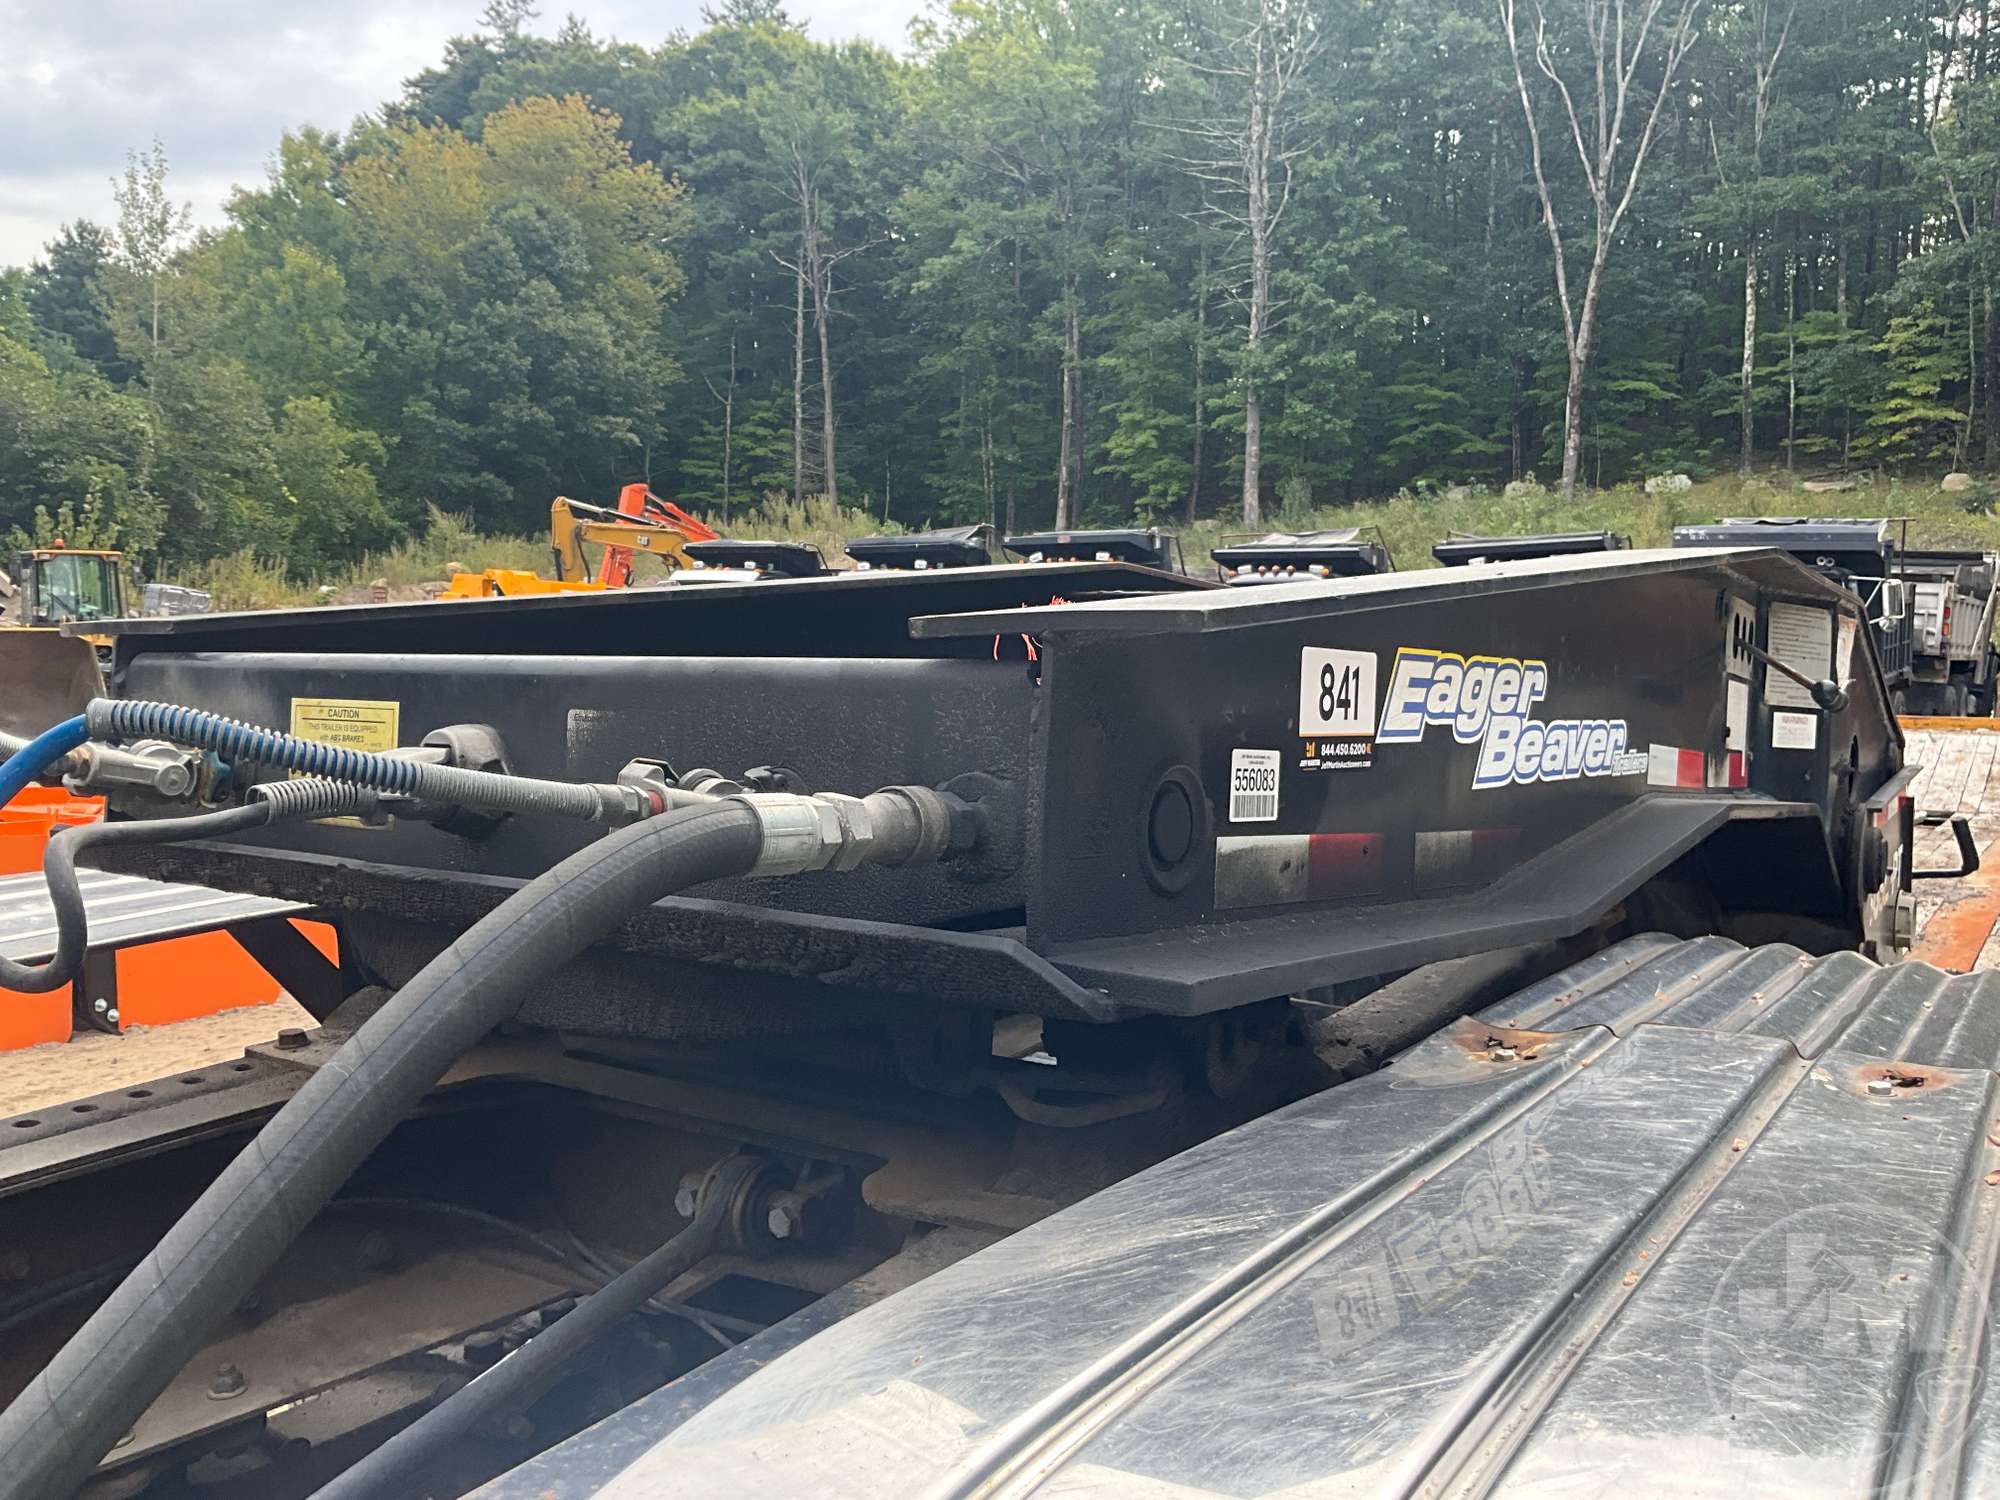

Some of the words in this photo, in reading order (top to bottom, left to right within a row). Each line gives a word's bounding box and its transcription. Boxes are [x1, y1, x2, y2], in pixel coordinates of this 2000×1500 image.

[1319, 663, 1360, 721] 841
[1376, 648, 1547, 744] Eager
[327, 708, 360, 719] CAUTION
[321, 723, 343, 732] TRAILER
[1321, 743, 1366, 757] 844.450.6200
[1472, 714, 1627, 790] Beaver
[1235, 768, 1275, 791] 556083
